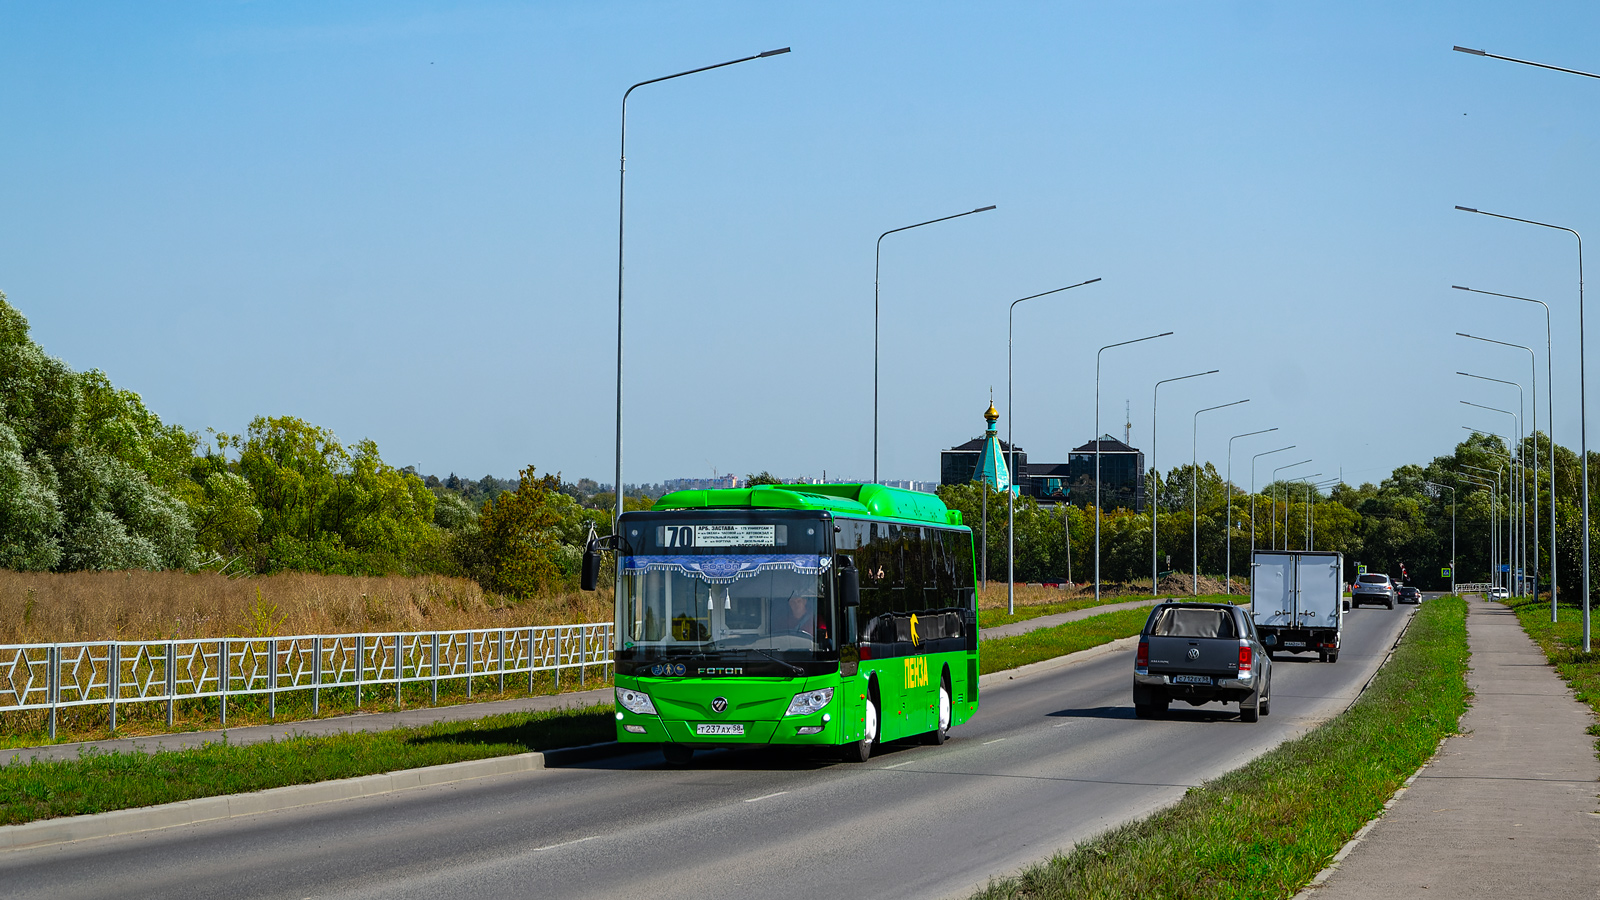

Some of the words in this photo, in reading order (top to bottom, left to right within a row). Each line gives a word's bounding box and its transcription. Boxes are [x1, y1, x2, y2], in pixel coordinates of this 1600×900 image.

[667, 526, 692, 548] 70
[697, 667, 743, 675] FOTON
[904, 656, 929, 690] ПЕНЗА
